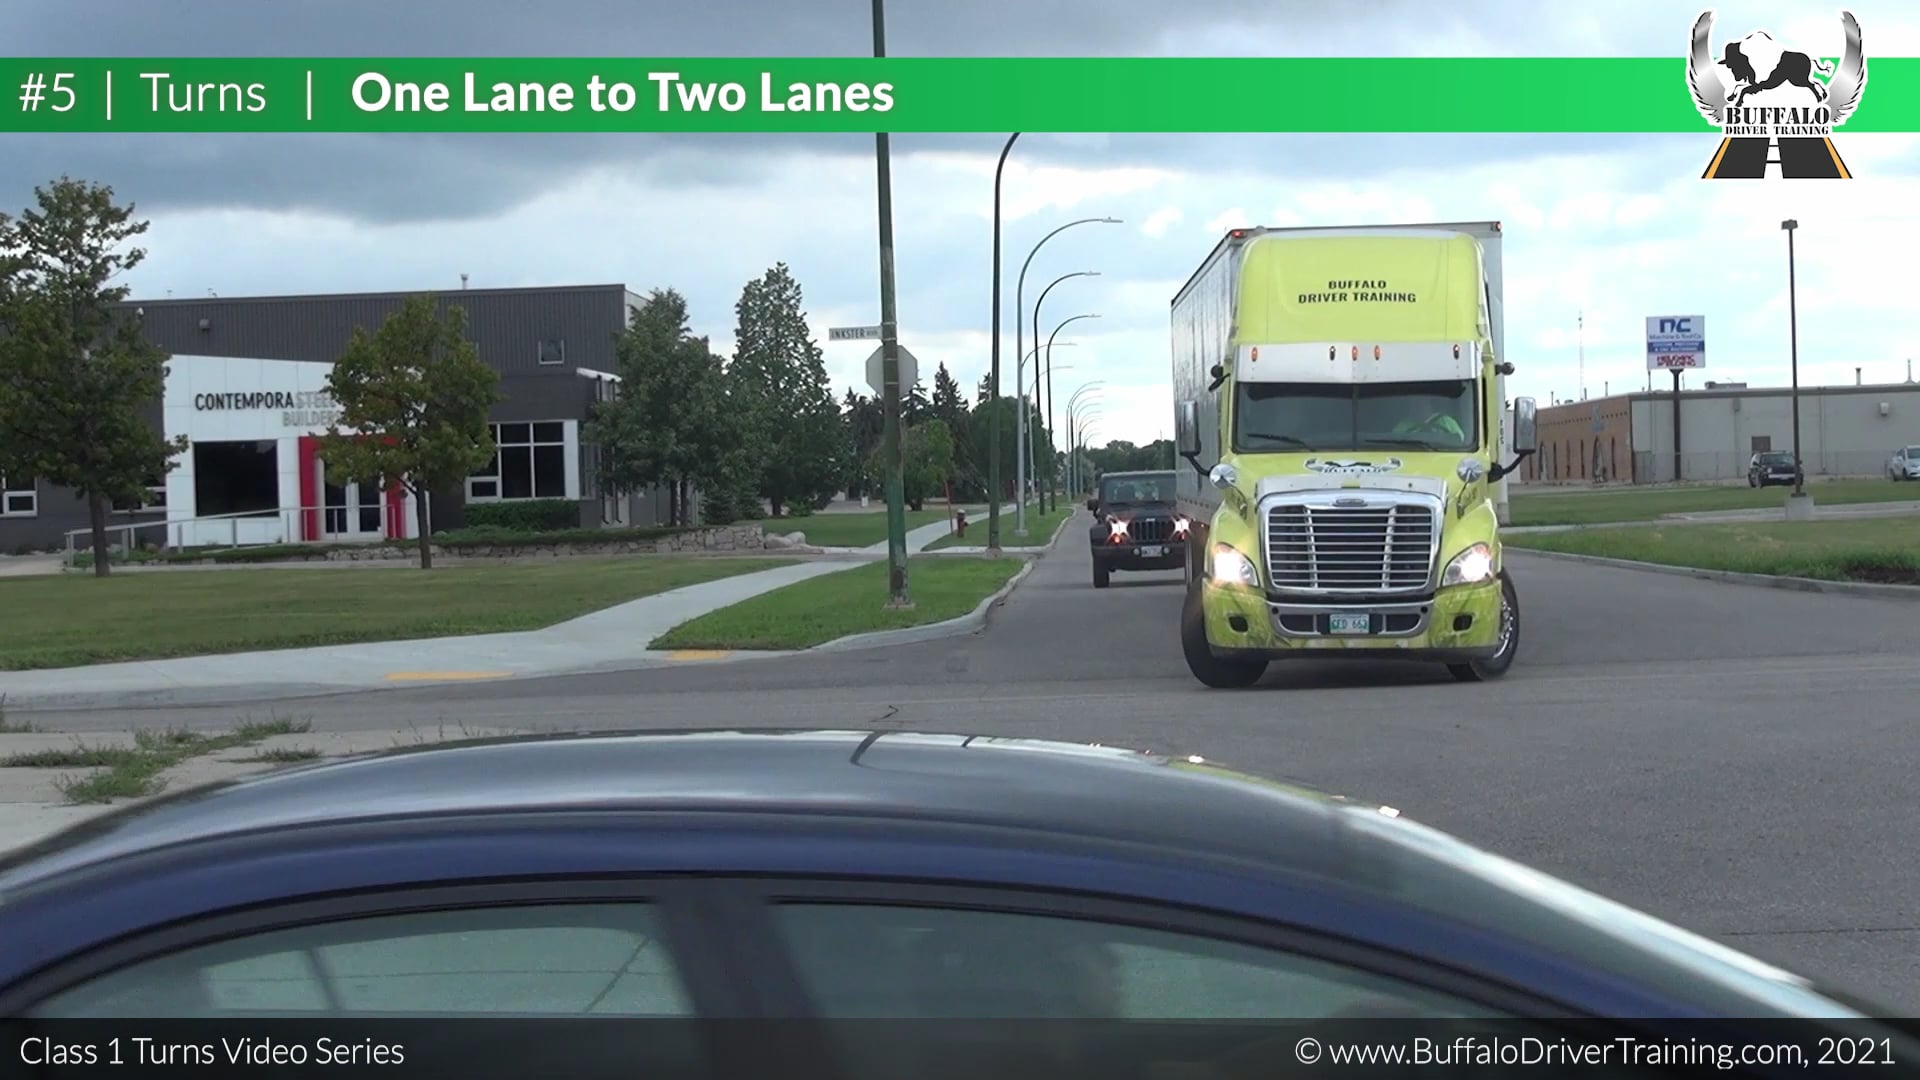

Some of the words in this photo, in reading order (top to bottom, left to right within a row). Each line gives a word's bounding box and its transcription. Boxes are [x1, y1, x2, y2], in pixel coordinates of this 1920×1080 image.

[1328, 280, 1387, 289] BUFFALO
[1298, 292, 1348, 304] DRIVER
[1351, 292, 1417, 303] TRAINING
[831, 328, 864, 340] INKSTER
[195, 391, 294, 411] CONTEMPORA
